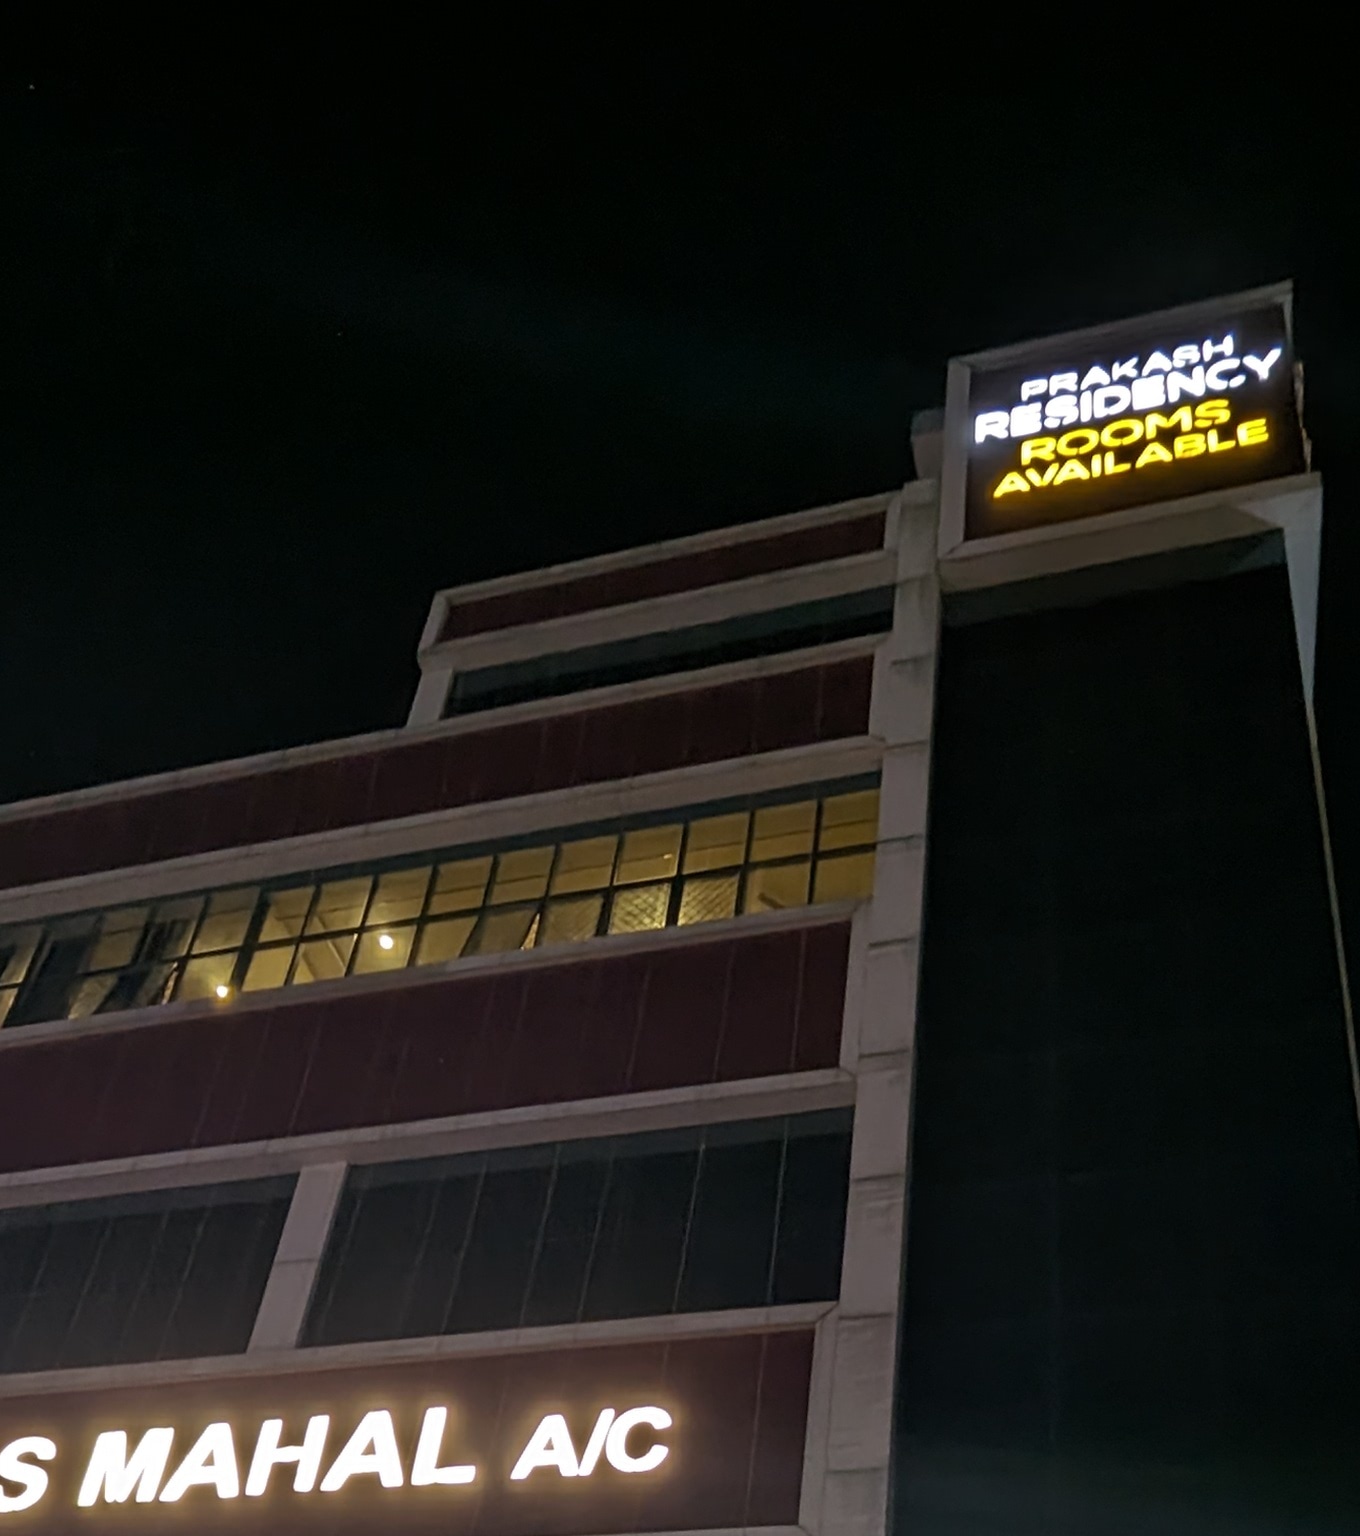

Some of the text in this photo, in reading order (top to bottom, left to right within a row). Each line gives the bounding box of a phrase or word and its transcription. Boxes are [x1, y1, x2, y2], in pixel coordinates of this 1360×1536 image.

[975, 347, 1282, 445] RESIDENCY
[1021, 333, 1235, 402] PRAKASH
[993, 418, 1269, 498] AVAILABLE
[1021, 399, 1231, 465] ROOMS
[77, 1406, 478, 1509] MAHAL
[510, 1405, 674, 1482] A/C
